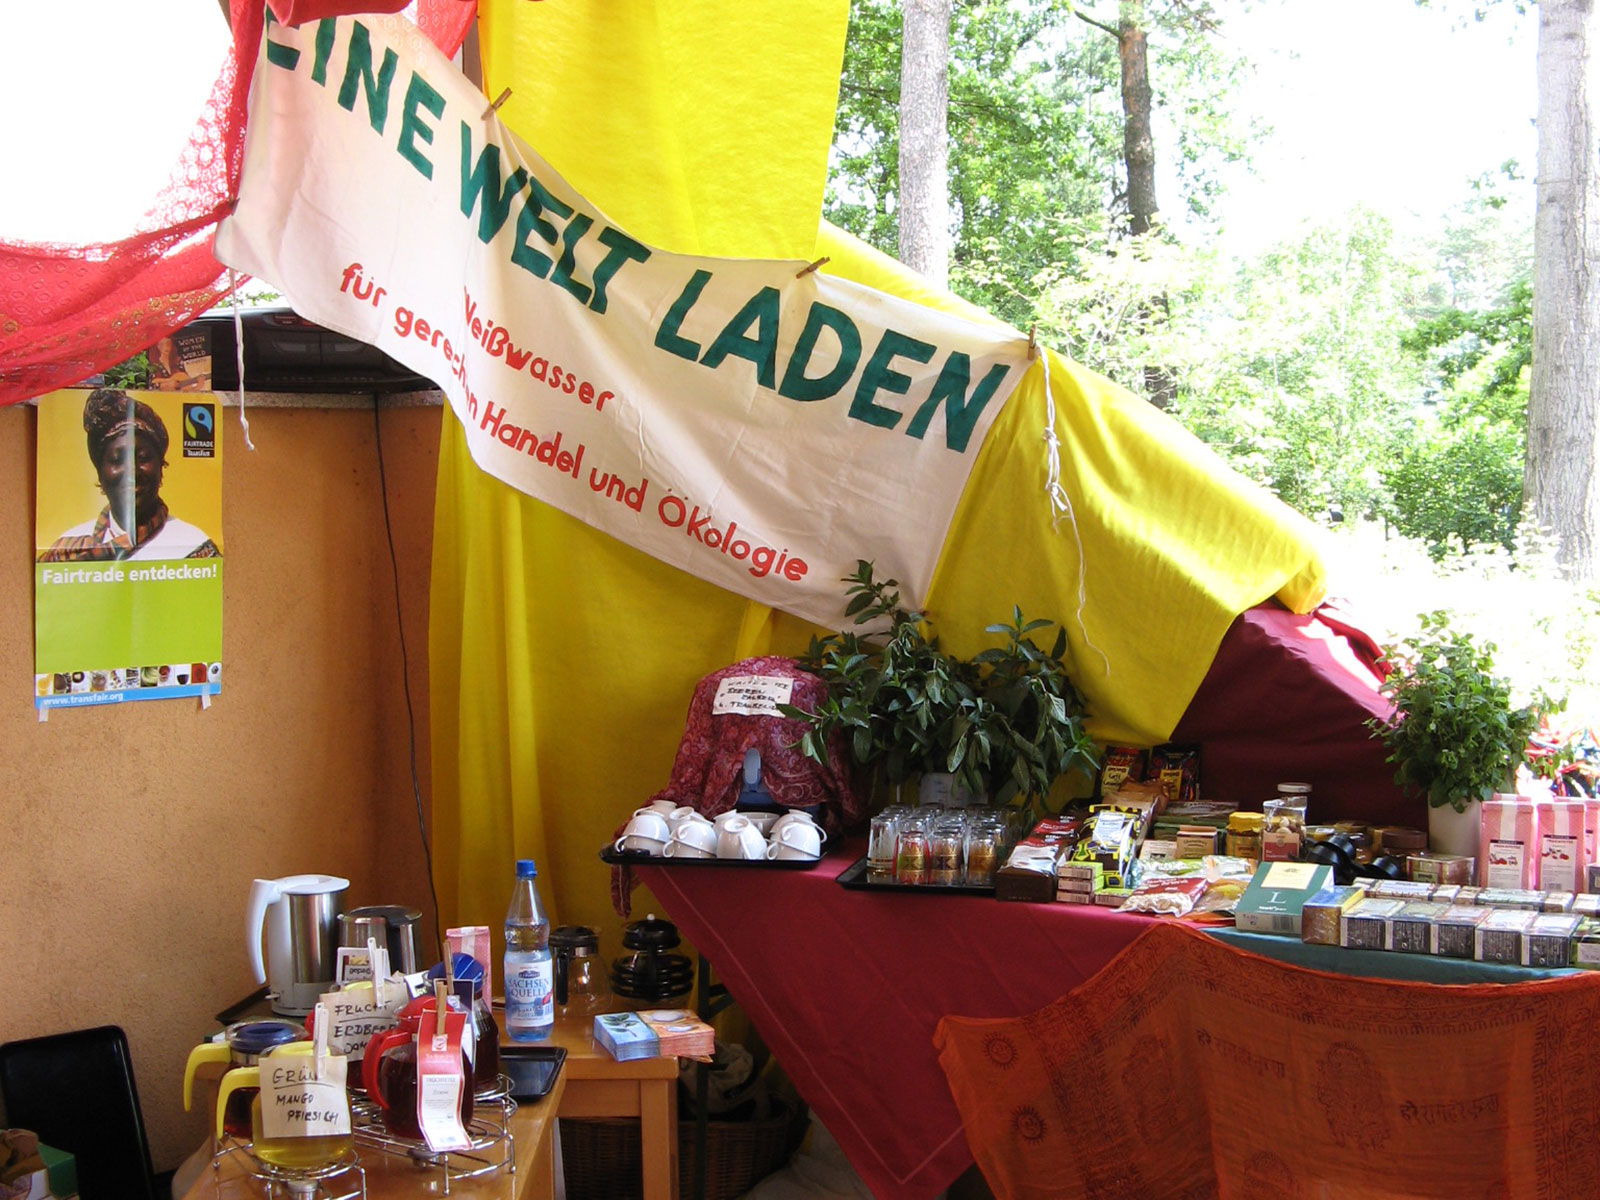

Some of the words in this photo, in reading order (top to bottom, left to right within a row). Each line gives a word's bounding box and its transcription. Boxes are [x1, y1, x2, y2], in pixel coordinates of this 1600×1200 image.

[460, 120, 652, 315] WELT
[654, 269, 1011, 453] LADEN
[183, 350, 207, 360] WORLD
[340, 263, 387, 307] für
[393, 306, 478, 420] gerechn
[480, 401, 585, 479] Handel
[589, 468, 648, 512] und
[184, 440, 214, 448] FAIRTRADE
[42, 567, 125, 585] Fairtrade
[129, 564, 217, 582] entdecken!
[43, 693, 124, 705] www.transfair.org
[276, 1093, 314, 1106] MANGO
